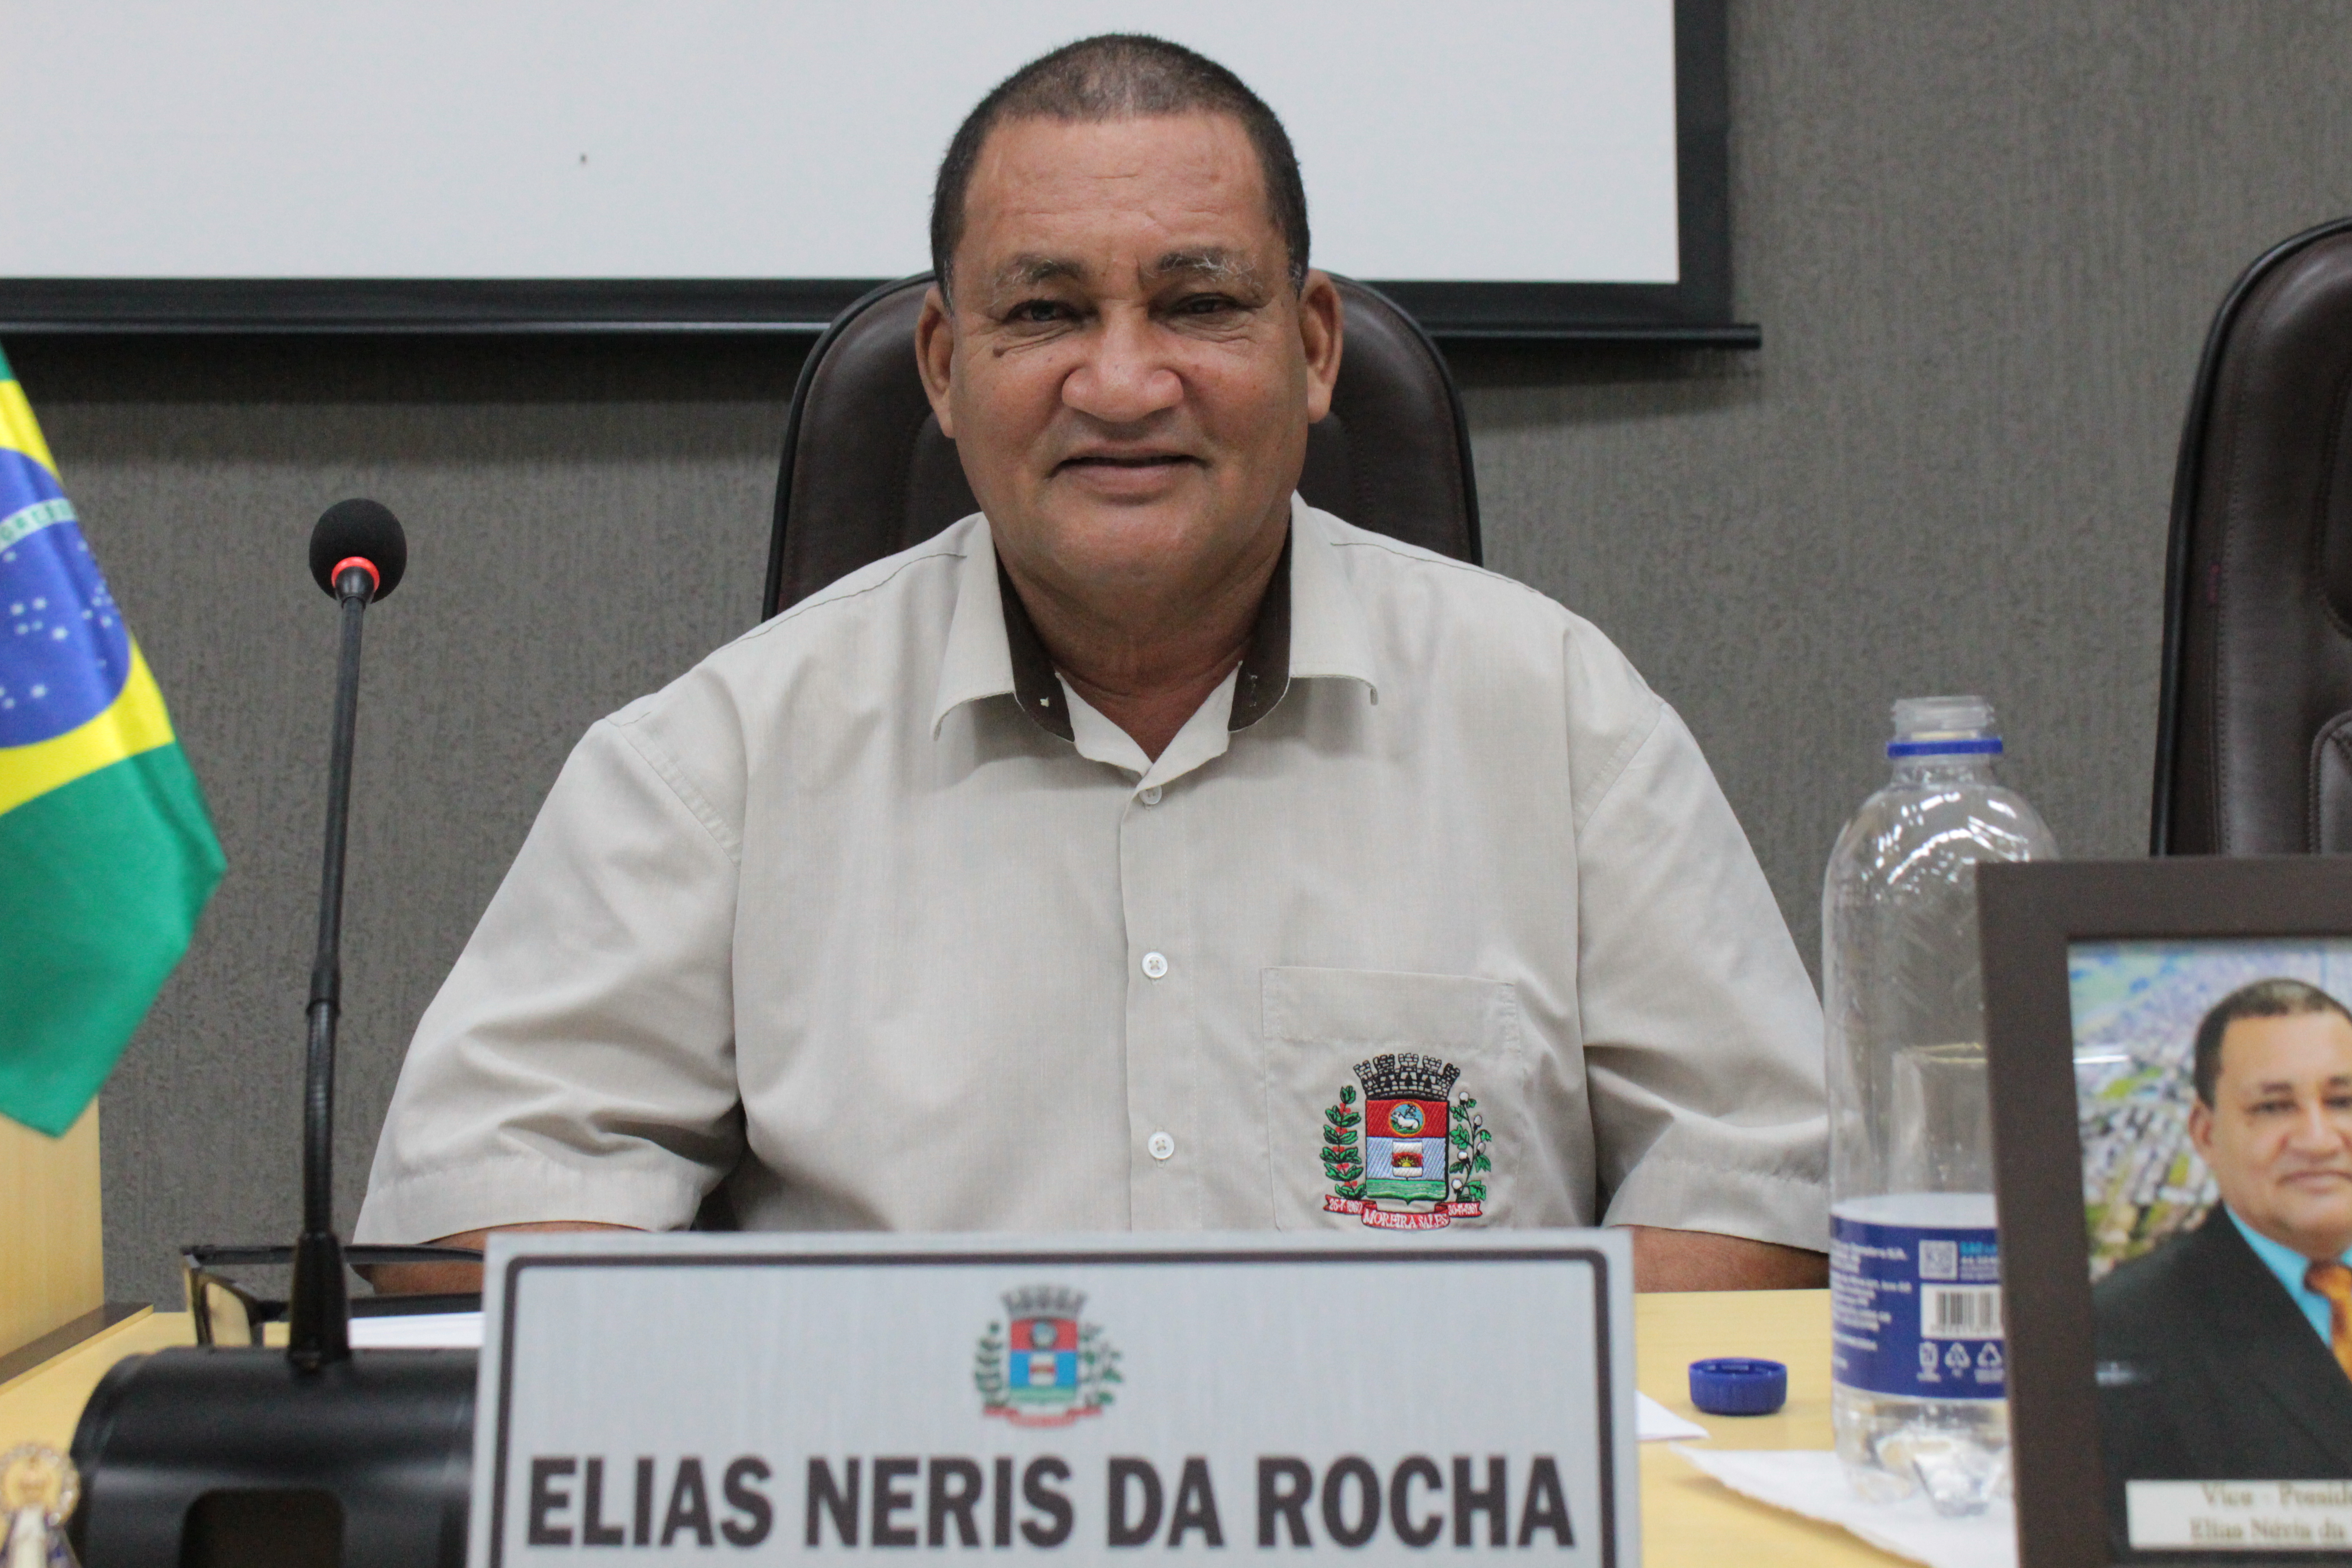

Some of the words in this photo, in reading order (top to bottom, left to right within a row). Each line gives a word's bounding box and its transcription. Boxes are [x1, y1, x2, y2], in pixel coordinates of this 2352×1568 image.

[1363, 1208, 1417, 1229] MOREIRA
[1418, 1214, 1449, 1229] SALES
[527, 1456, 773, 1548] ELIAS
[805, 1456, 1074, 1549] NERIS
[1107, 1457, 1224, 1548] DA
[1258, 1455, 1575, 1549] ROCHA
